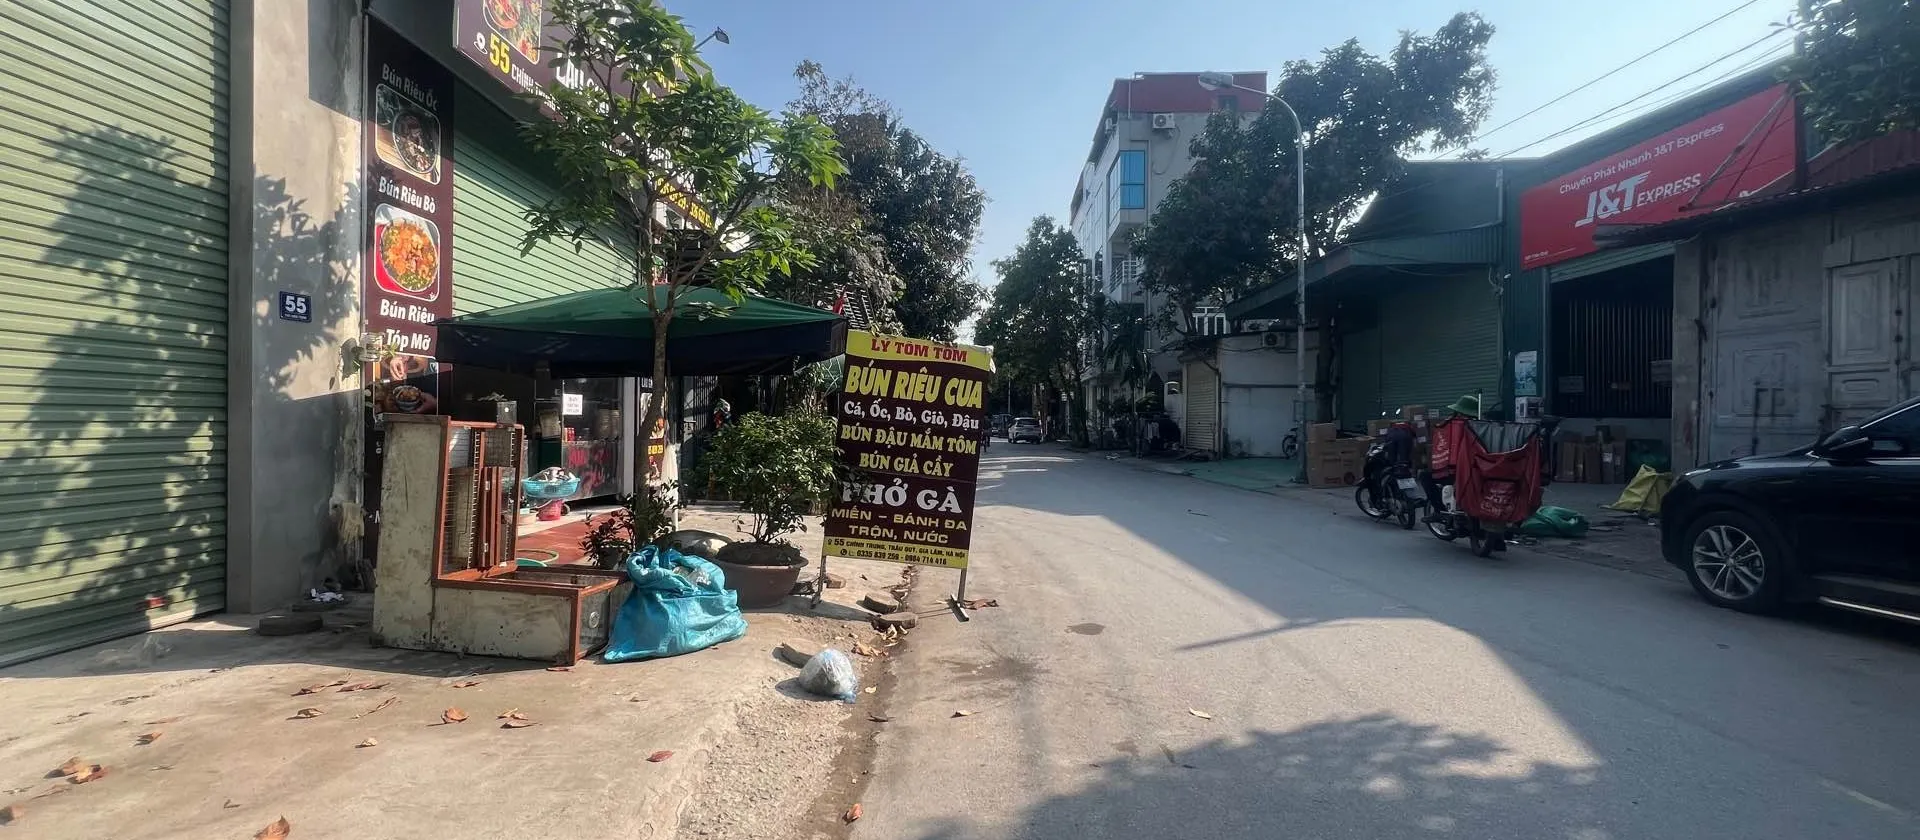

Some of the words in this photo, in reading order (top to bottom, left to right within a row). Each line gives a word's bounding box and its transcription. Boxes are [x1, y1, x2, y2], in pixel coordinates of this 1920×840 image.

[489, 32, 510, 74] 55
[381, 63, 402, 89] Bún
[404, 77, 425, 102] Riêu
[1594, 165, 1616, 181] Phát
[1618, 150, 1652, 172] Nhanh
[1654, 140, 1675, 157] J&T
[1677, 123, 1724, 149] Express
[378, 176, 399, 200] Bún
[401, 184, 423, 210] Riêu
[423, 194, 436, 214] Bò
[1574, 170, 1651, 228] J&T
[1637, 173, 1701, 207] EXPRESS
[285, 295, 307, 314] 55
[380, 298, 405, 320] Bún
[408, 304, 435, 323] Riêu
[410, 332, 431, 351] Mỡ
[894, 340, 929, 358] TÔM
[933, 343, 968, 363] TÔM
[844, 359, 893, 397] BÚN
[892, 366, 943, 403] RIÊU
[944, 377, 983, 409] CUA
[844, 400, 865, 418] Cá,
[869, 397, 891, 421] Ốc,
[895, 406, 917, 424] Bò,
[921, 410, 948, 428] Giò,
[951, 413, 979, 431] Đậu
[841, 422, 872, 442] BÚN
[875, 426, 908, 448] ĐẬU
[910, 427, 944, 451] MẮM
[947, 434, 977, 454] TÔM
[859, 450, 891, 470] BÚN
[893, 453, 919, 474] GIẢ
[923, 454, 954, 477] CẦY
[917, 485, 962, 513] GÀ
[848, 524, 898, 540] TRỘN,
[903, 530, 949, 544] NƯỚC
[893, 512, 939, 527] BÁNH
[944, 518, 967, 531] ĐA
[834, 538, 845, 546] 55
